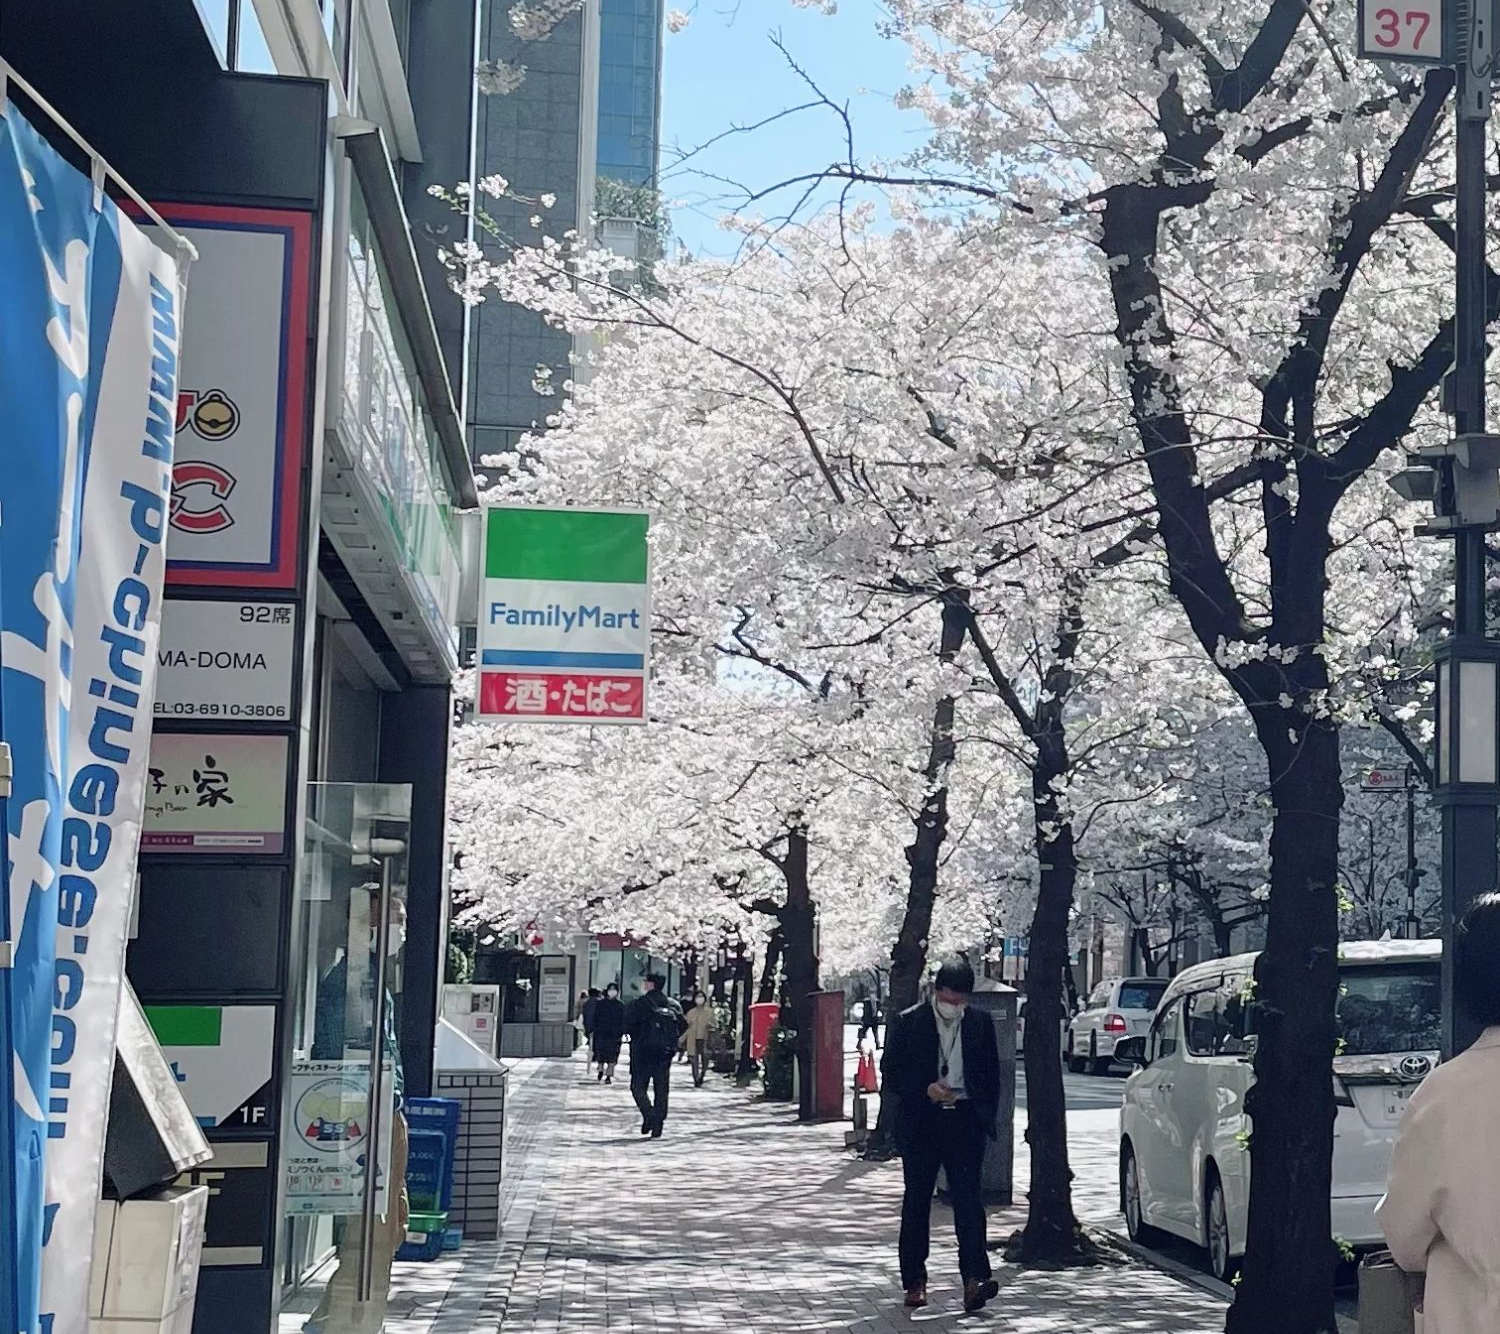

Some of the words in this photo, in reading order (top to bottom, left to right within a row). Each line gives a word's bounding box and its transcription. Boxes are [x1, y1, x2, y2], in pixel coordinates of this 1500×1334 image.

[1375, 8, 1430, 51] 37
[239, 605, 292, 625] 92席
[489, 602, 640, 633] FamilyMart
[239, 1106, 266, 1124] 1F
